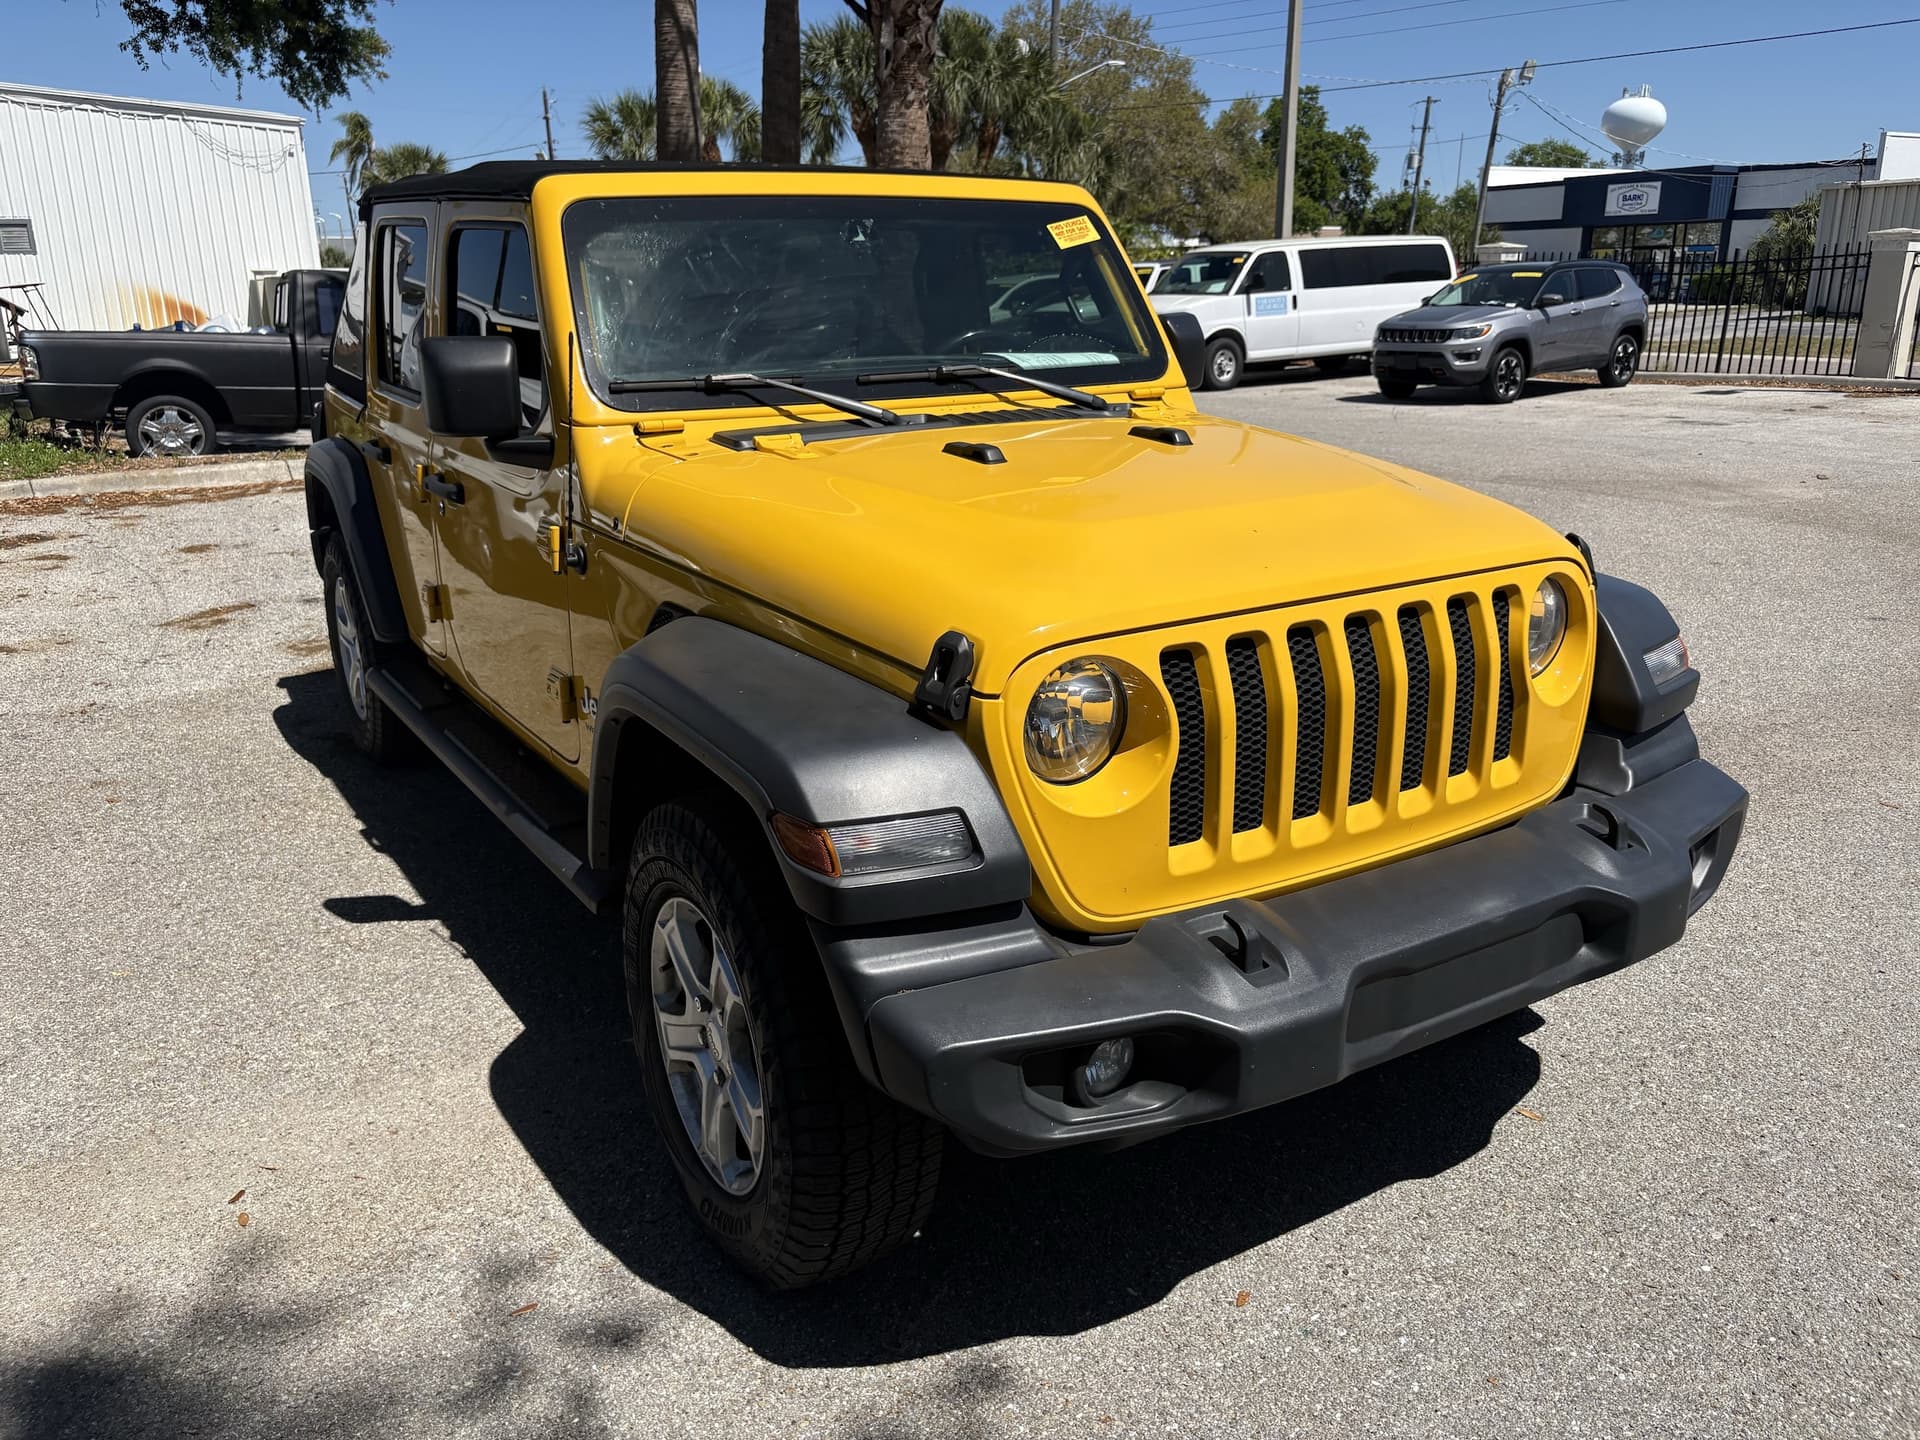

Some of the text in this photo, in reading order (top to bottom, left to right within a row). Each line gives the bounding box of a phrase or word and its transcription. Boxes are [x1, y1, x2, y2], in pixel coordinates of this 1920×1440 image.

[1050, 218, 1087, 232] THIS VEHICLE
[1066, 227, 1076, 235] FOR
[581, 686, 598, 720] Je
